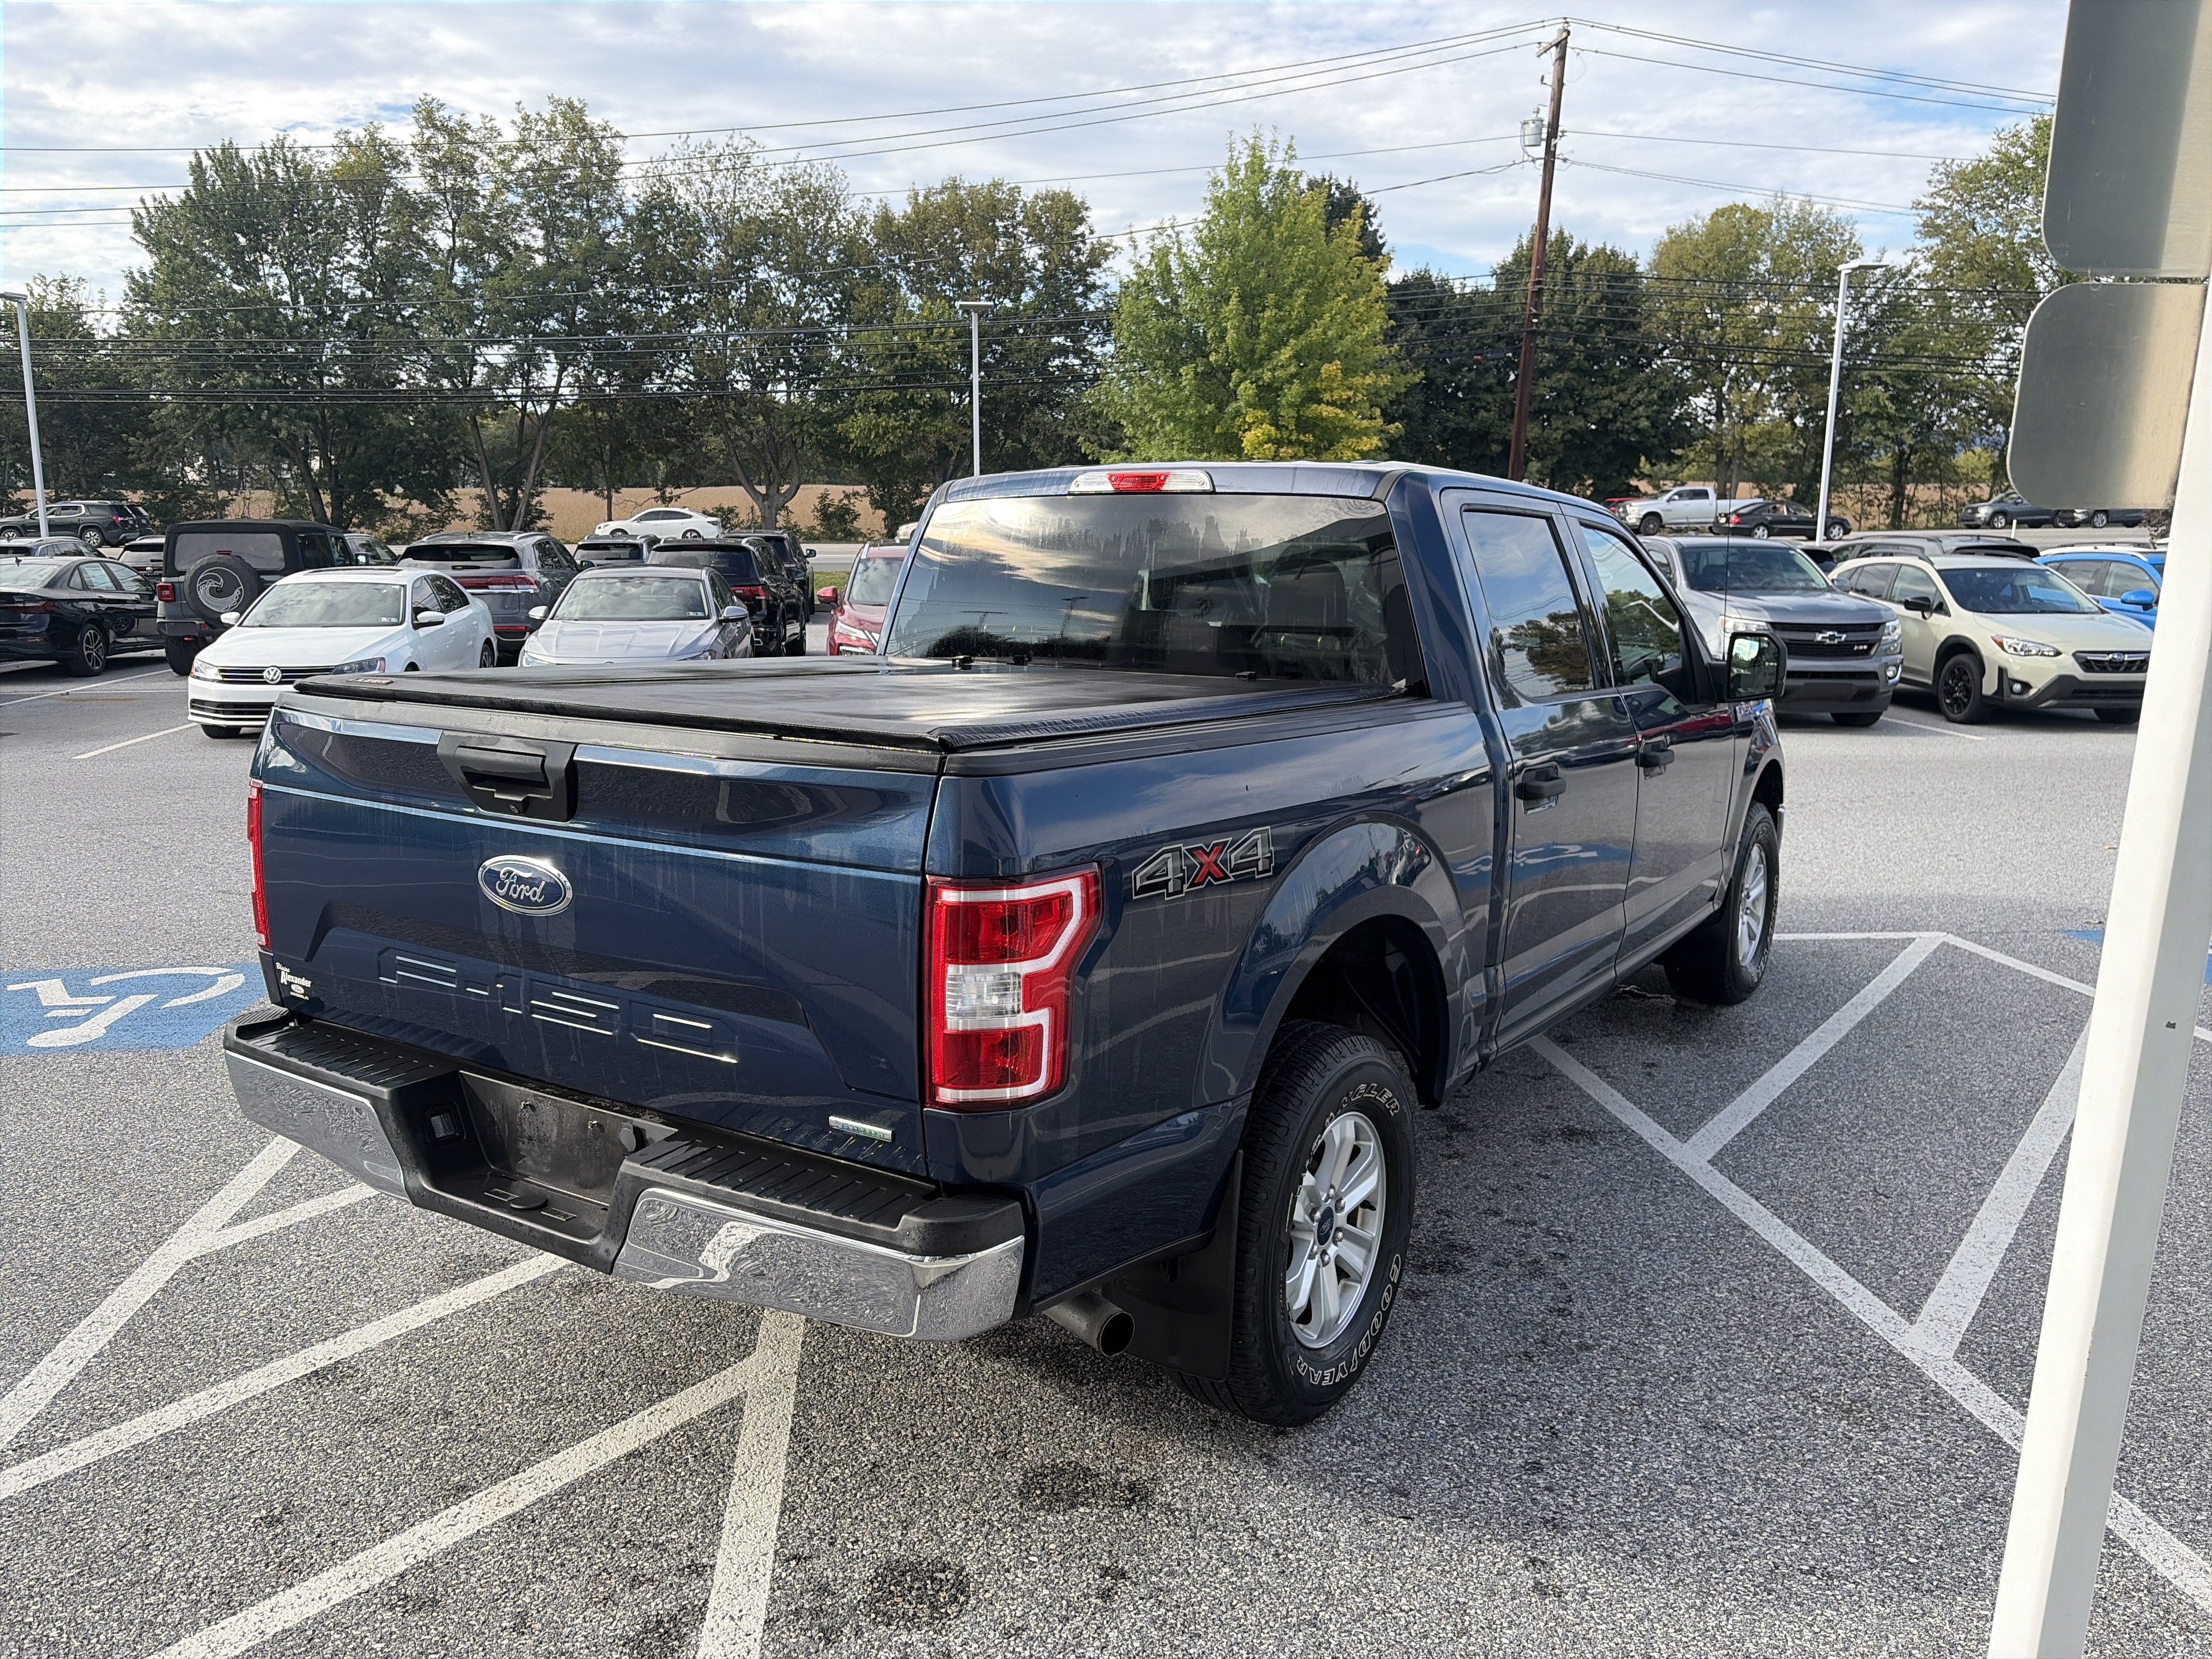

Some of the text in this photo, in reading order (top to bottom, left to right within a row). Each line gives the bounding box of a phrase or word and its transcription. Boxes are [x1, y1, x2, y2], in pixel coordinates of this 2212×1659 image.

[495, 866, 546, 904] Ford
[280, 970, 312, 988] Alexander
[378, 946, 738, 1064] F-150
[1296, 1254, 1401, 1386] GOODYEAR
